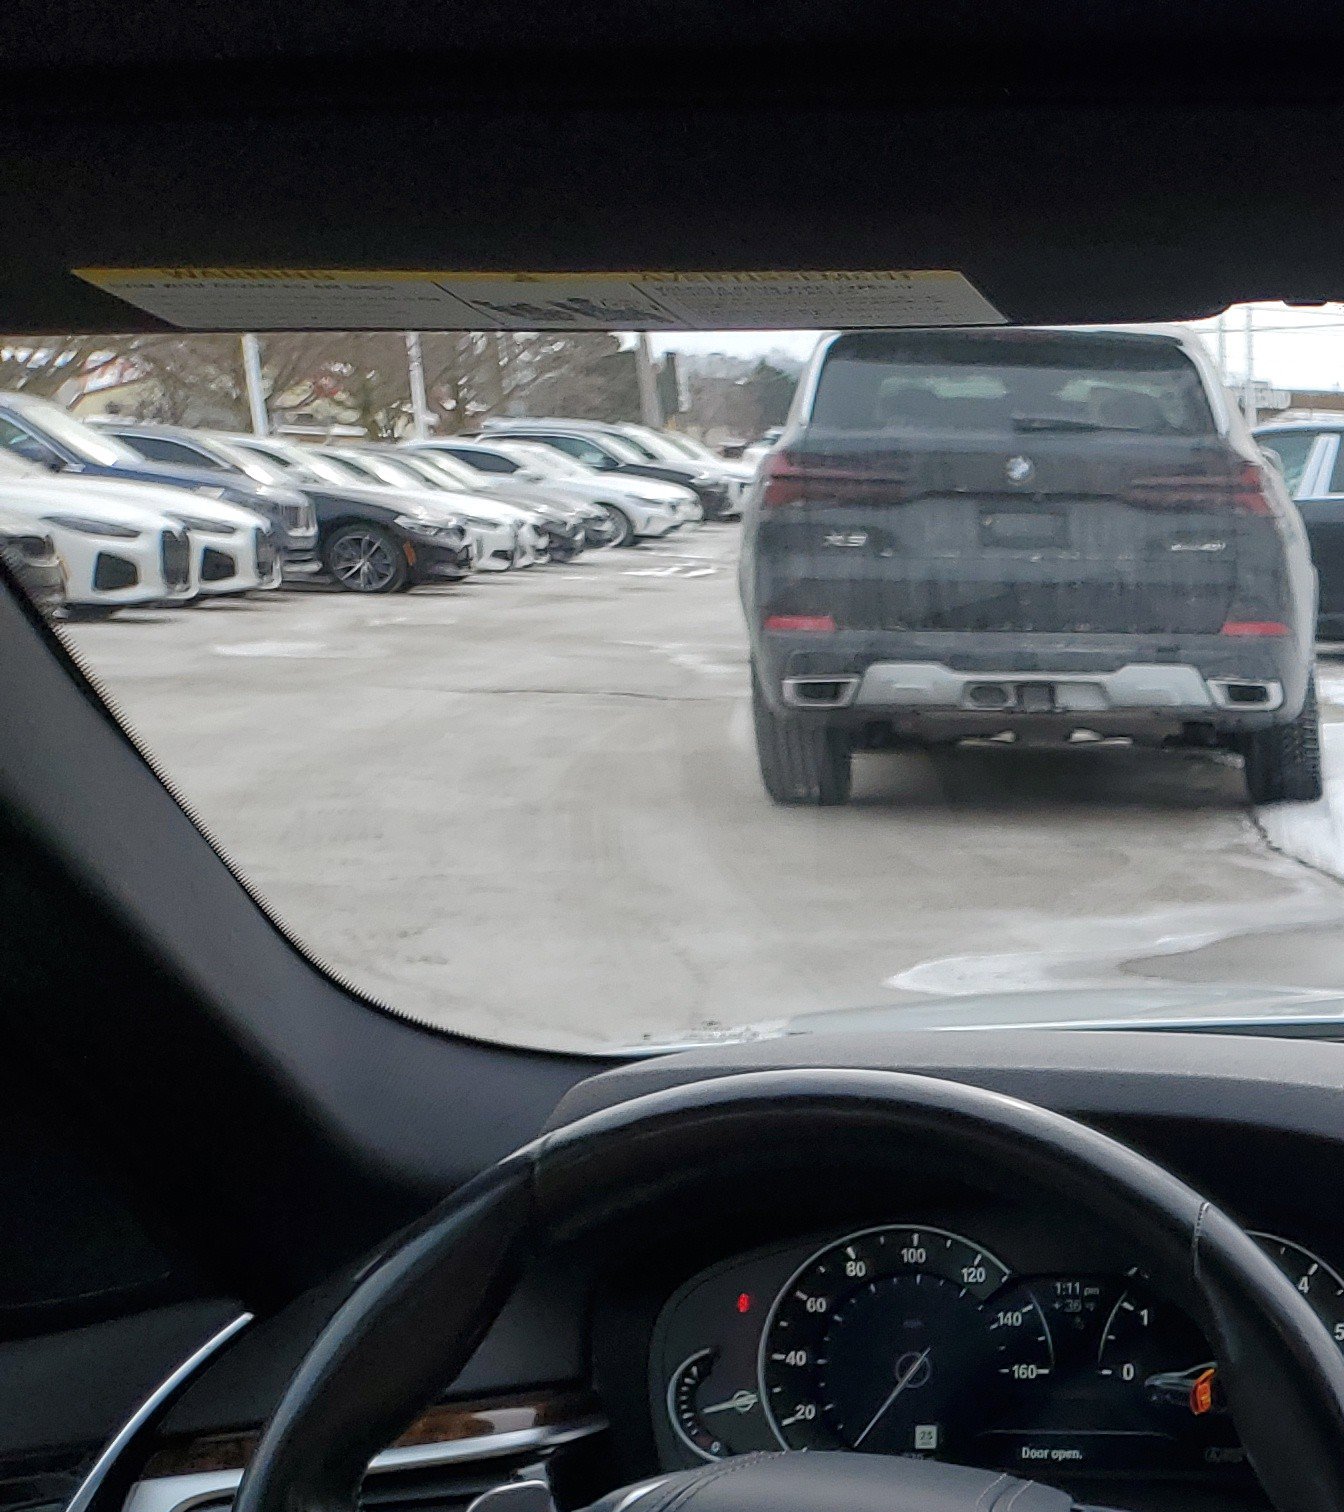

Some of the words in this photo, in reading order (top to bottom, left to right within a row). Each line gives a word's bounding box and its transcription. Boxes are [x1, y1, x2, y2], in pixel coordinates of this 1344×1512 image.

[901, 1248, 926, 1264] 100
[846, 1261, 866, 1277] 80
[961, 1267, 986, 1283] 120
[1055, 1282, 1081, 1296] 1:11
[1298, 1276, 1310, 1294] 4
[806, 1301, 827, 1313] 60
[997, 1311, 1022, 1327] 140
[1140, 1309, 1149, 1327] 1
[785, 1350, 807, 1367] 40
[1012, 1364, 1037, 1379] 160
[1122, 1363, 1134, 1381] 0
[795, 1404, 816, 1420] 20
[1022, 1447, 1049, 1459] Door
[1051, 1450, 1083, 1461] open.
